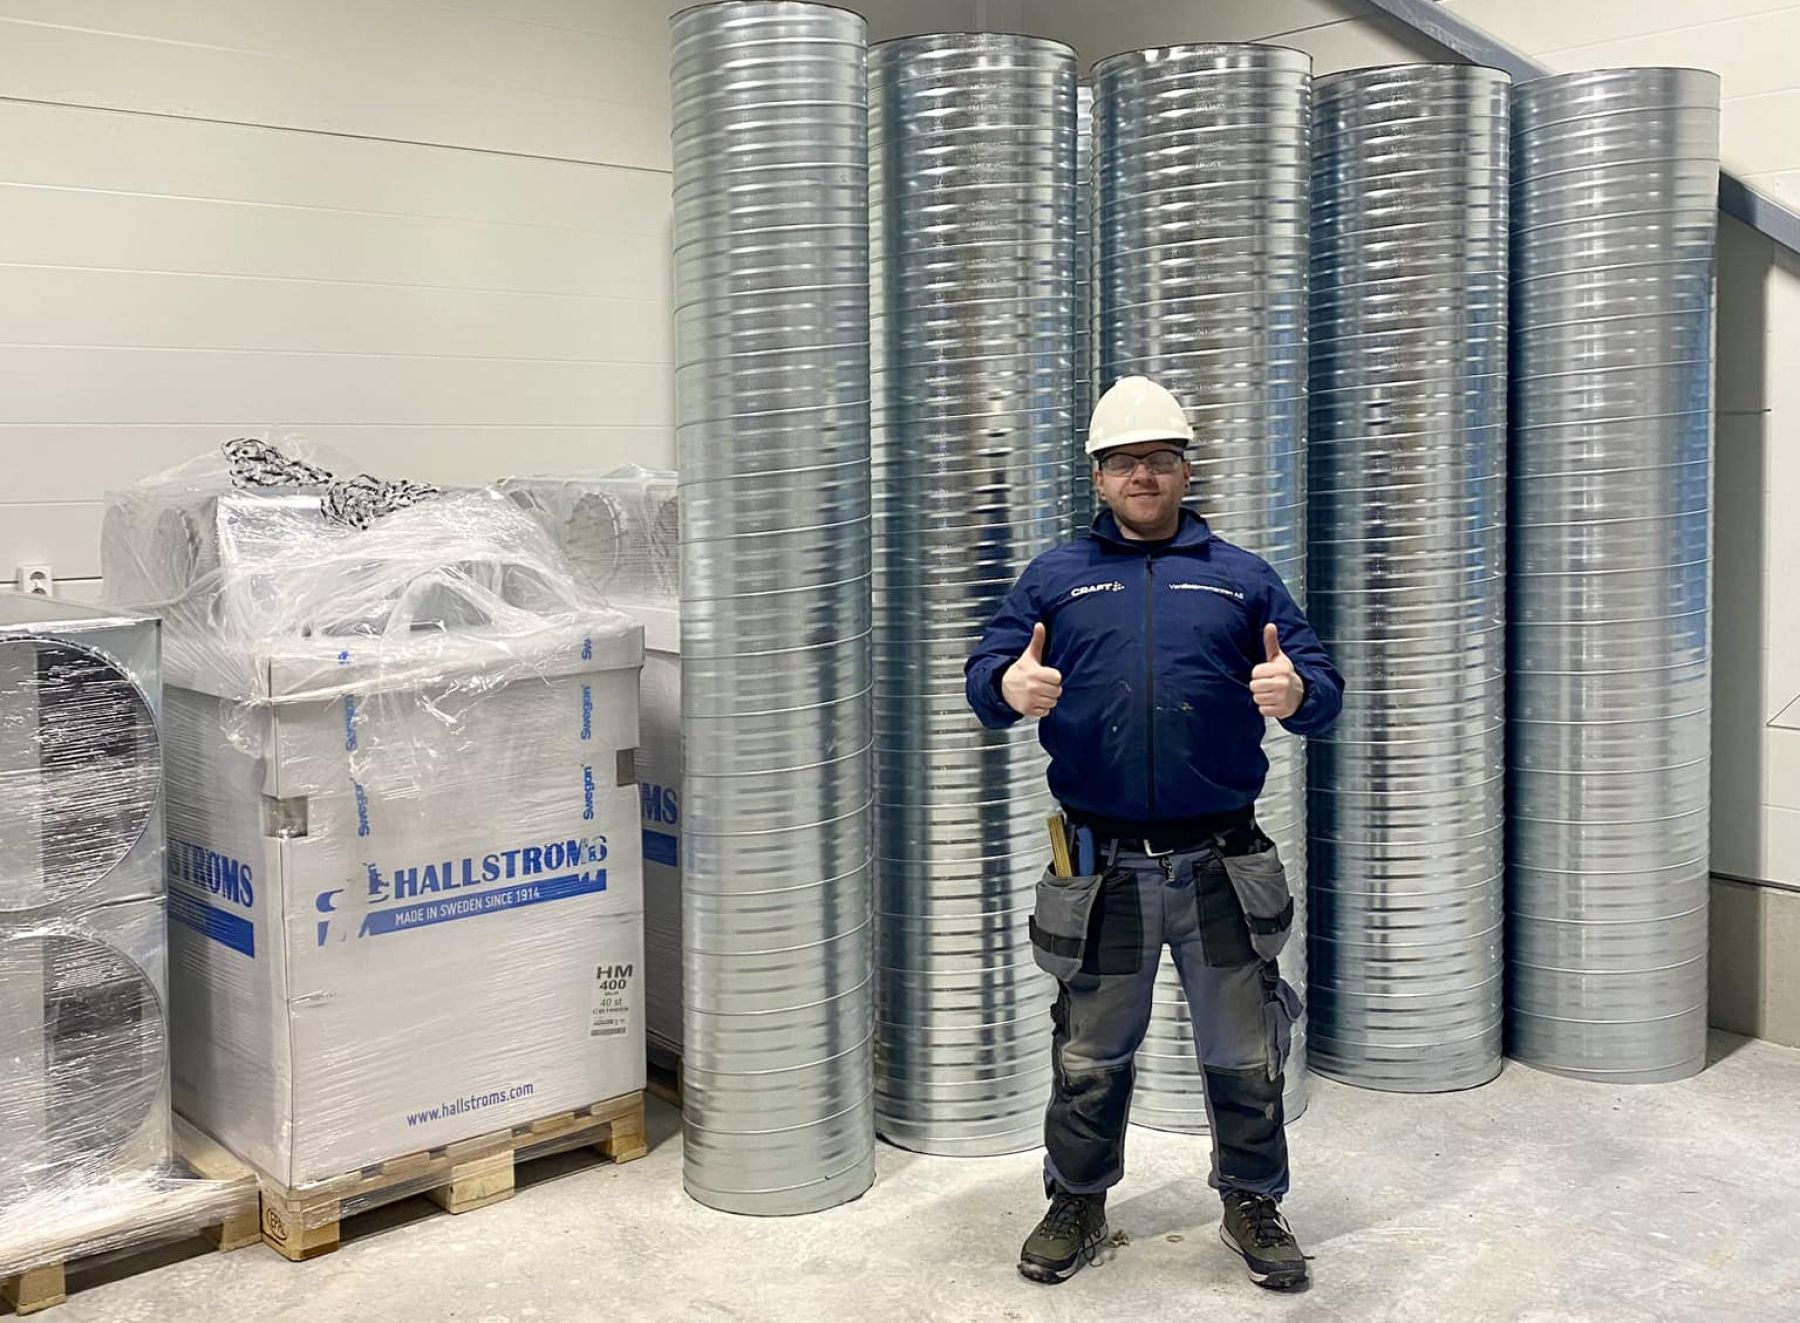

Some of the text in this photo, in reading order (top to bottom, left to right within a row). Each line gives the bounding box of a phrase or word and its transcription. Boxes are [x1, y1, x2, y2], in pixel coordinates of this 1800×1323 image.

[1070, 582, 1113, 597] CRAFT
[580, 684, 593, 740] Swegon
[583, 765, 595, 821] Swegon
[395, 886, 541, 926] MADE IN SWEDEN SINCE 1914
[596, 964, 633, 979] HM
[599, 979, 627, 990] 400
[406, 1083, 534, 1127] www.hallstroms.com
